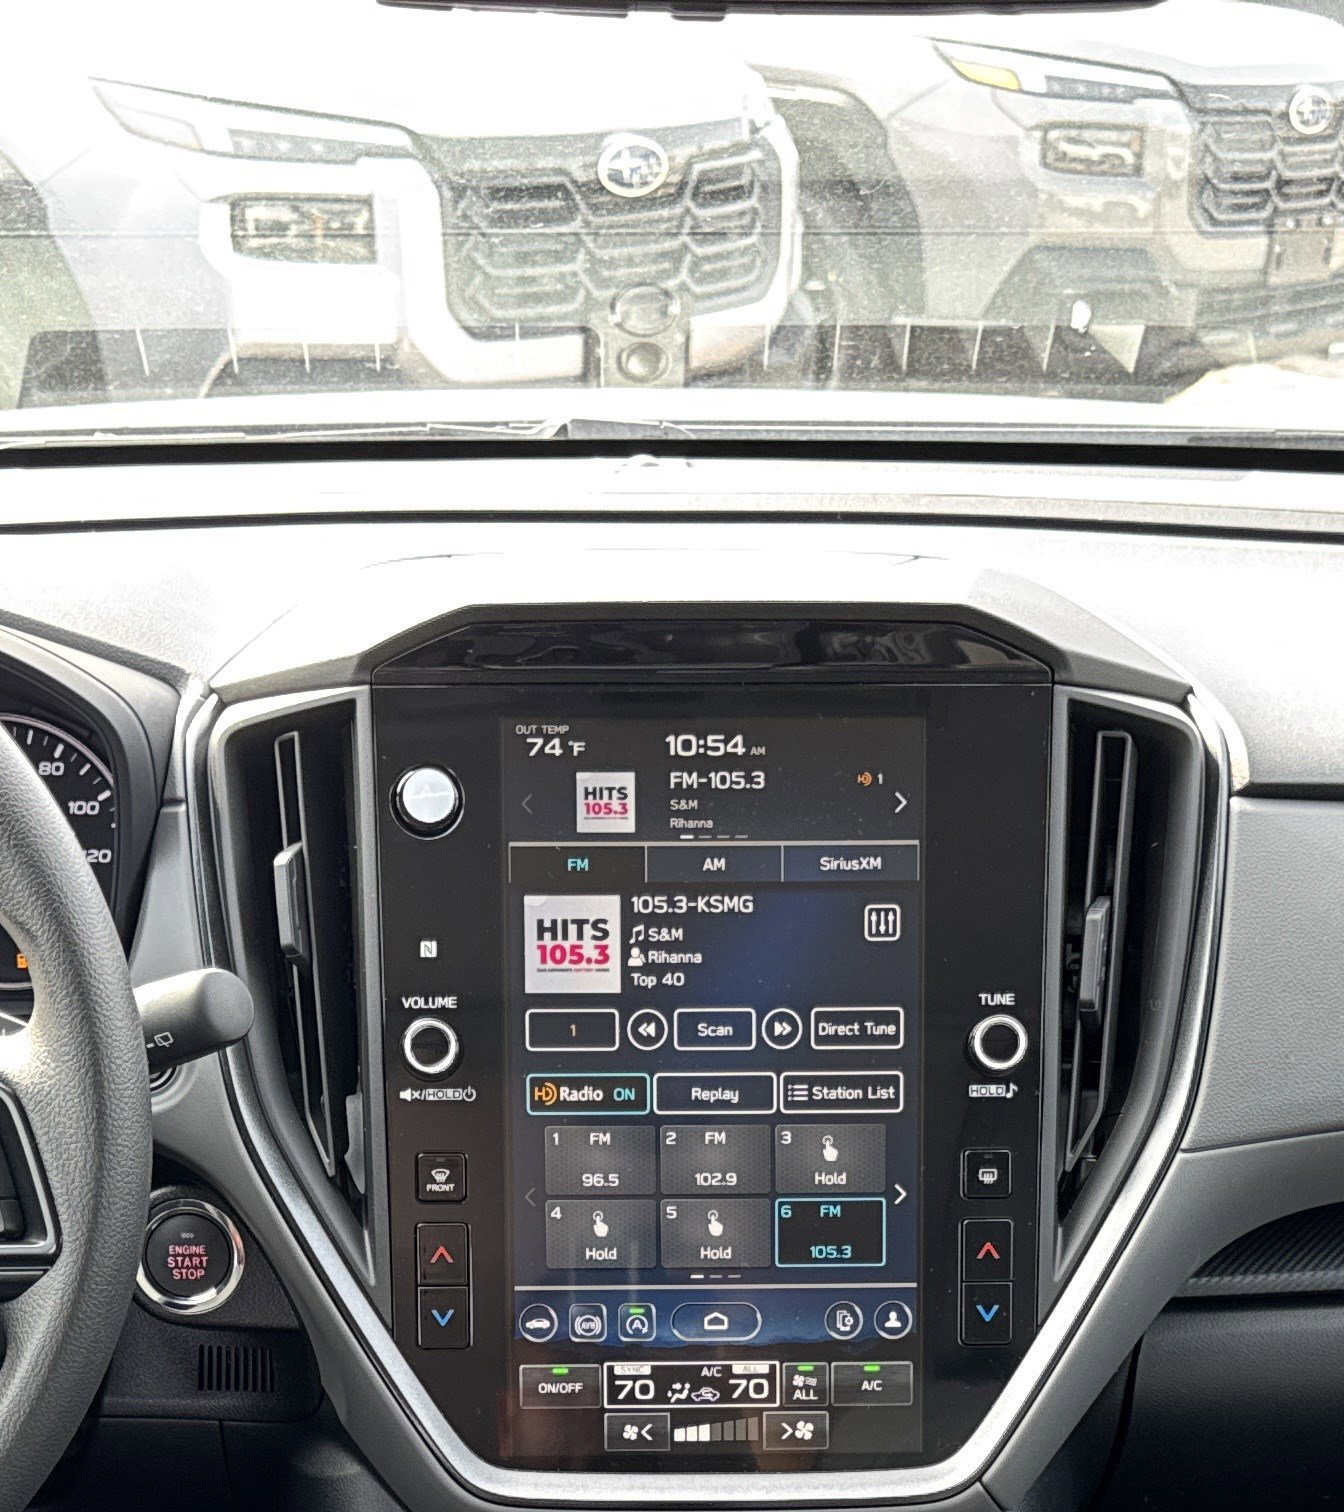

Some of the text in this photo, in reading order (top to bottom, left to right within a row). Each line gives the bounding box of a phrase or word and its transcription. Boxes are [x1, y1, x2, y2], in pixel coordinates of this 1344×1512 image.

[516, 724, 569, 734] OUT TEMP
[526, 738, 563, 756] 74
[665, 734, 765, 756] 10:54 AM
[38, 762, 65, 776] 80
[670, 771, 765, 789] FM-105.3
[877, 773, 883, 784] 1
[584, 787, 628, 800] HITS
[68, 801, 100, 815] 100
[584, 802, 628, 815] 105.3
[670, 800, 698, 810] S&M
[670, 818, 713, 828] Rihanna
[567, 858, 588, 871] FM
[702, 858, 726, 871] AM
[820, 857, 882, 870] SiriusXM
[631, 896, 753, 913] 105.3-KSMG
[537, 919, 610, 941] HITS
[648, 928, 683, 941] S&M
[537, 944, 610, 965] 105.3
[648, 951, 702, 964] Rihanna
[631, 973, 685, 989] Top 40
[402, 997, 457, 1009] VOLUME
[978, 993, 1015, 1005] TUNE
[570, 1025, 576, 1037] 1
[697, 1024, 732, 1037] Scan
[818, 1022, 896, 1036] Direct Tune
[427, 1089, 462, 1100] HOLD
[560, 1087, 636, 1101] Radio ON
[691, 1088, 739, 1103] Replay
[812, 1086, 895, 1100] Station List
[970, 1086, 1005, 1096] HOLD
[552, 1133, 611, 1145] 1 FM
[666, 1131, 726, 1144] 2 FM
[781, 1131, 792, 1144] 3
[582, 1174, 619, 1187] 96.5
[694, 1173, 737, 1186] 102.9
[814, 1172, 846, 1185] Hold
[426, 1184, 455, 1192] FRONT
[550, 1207, 562, 1219] 4
[666, 1207, 677, 1219] 5
[781, 1205, 841, 1218] 6 FM
[168, 1245, 206, 1255] ENGINE
[585, 1248, 617, 1260] Hold
[700, 1247, 732, 1259] Hold
[810, 1246, 852, 1258] 105.3
[167, 1256, 208, 1268] START
[172, 1268, 205, 1280] STOP
[701, 1367, 722, 1377] A/C
[538, 1382, 583, 1394] ON/OFF
[614, 1380, 655, 1400] 70
[728, 1379, 769, 1399] 70
[861, 1381, 883, 1391] A/C
[793, 1389, 818, 1400] ALL
